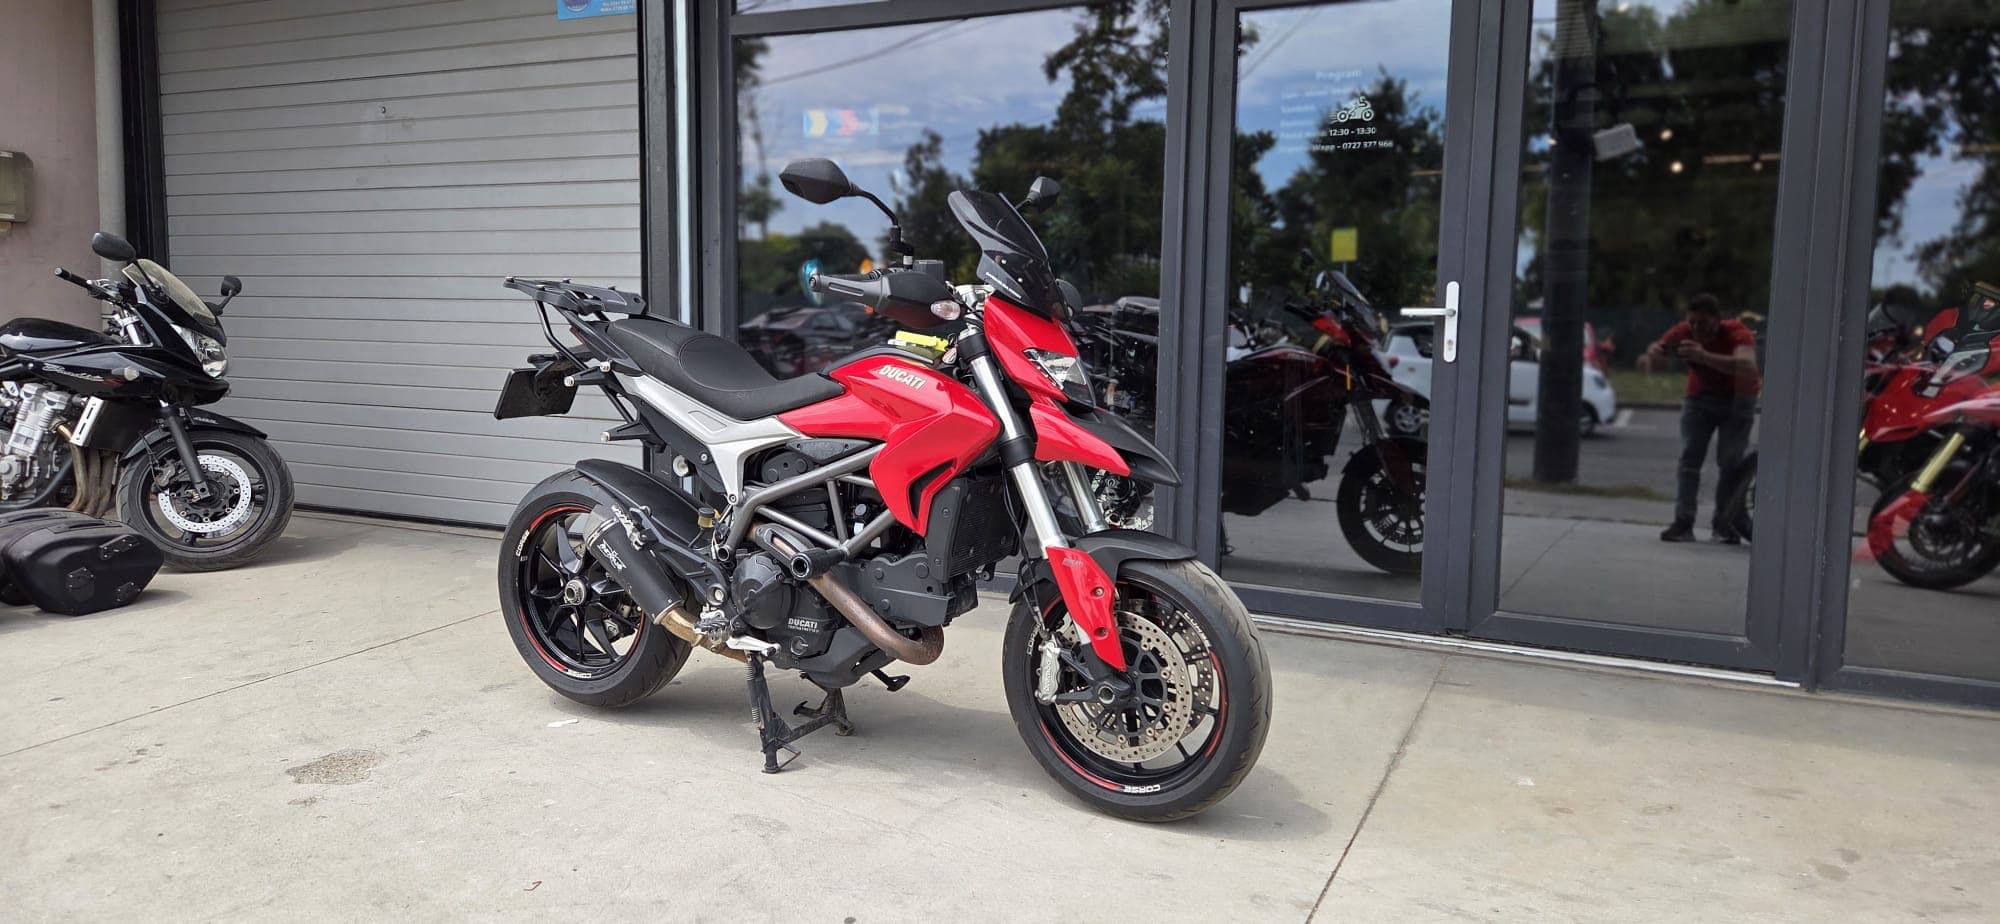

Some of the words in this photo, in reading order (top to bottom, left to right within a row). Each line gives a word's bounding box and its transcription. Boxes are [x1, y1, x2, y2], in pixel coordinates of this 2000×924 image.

[1316, 70, 1361, 81] Program
[1329, 127, 1349, 136] 12:30
[1356, 127, 1376, 135] 13:30
[1342, 142, 1361, 150] 0727
[879, 364, 926, 390] DUCATI
[788, 618, 818, 629] DUCATI
